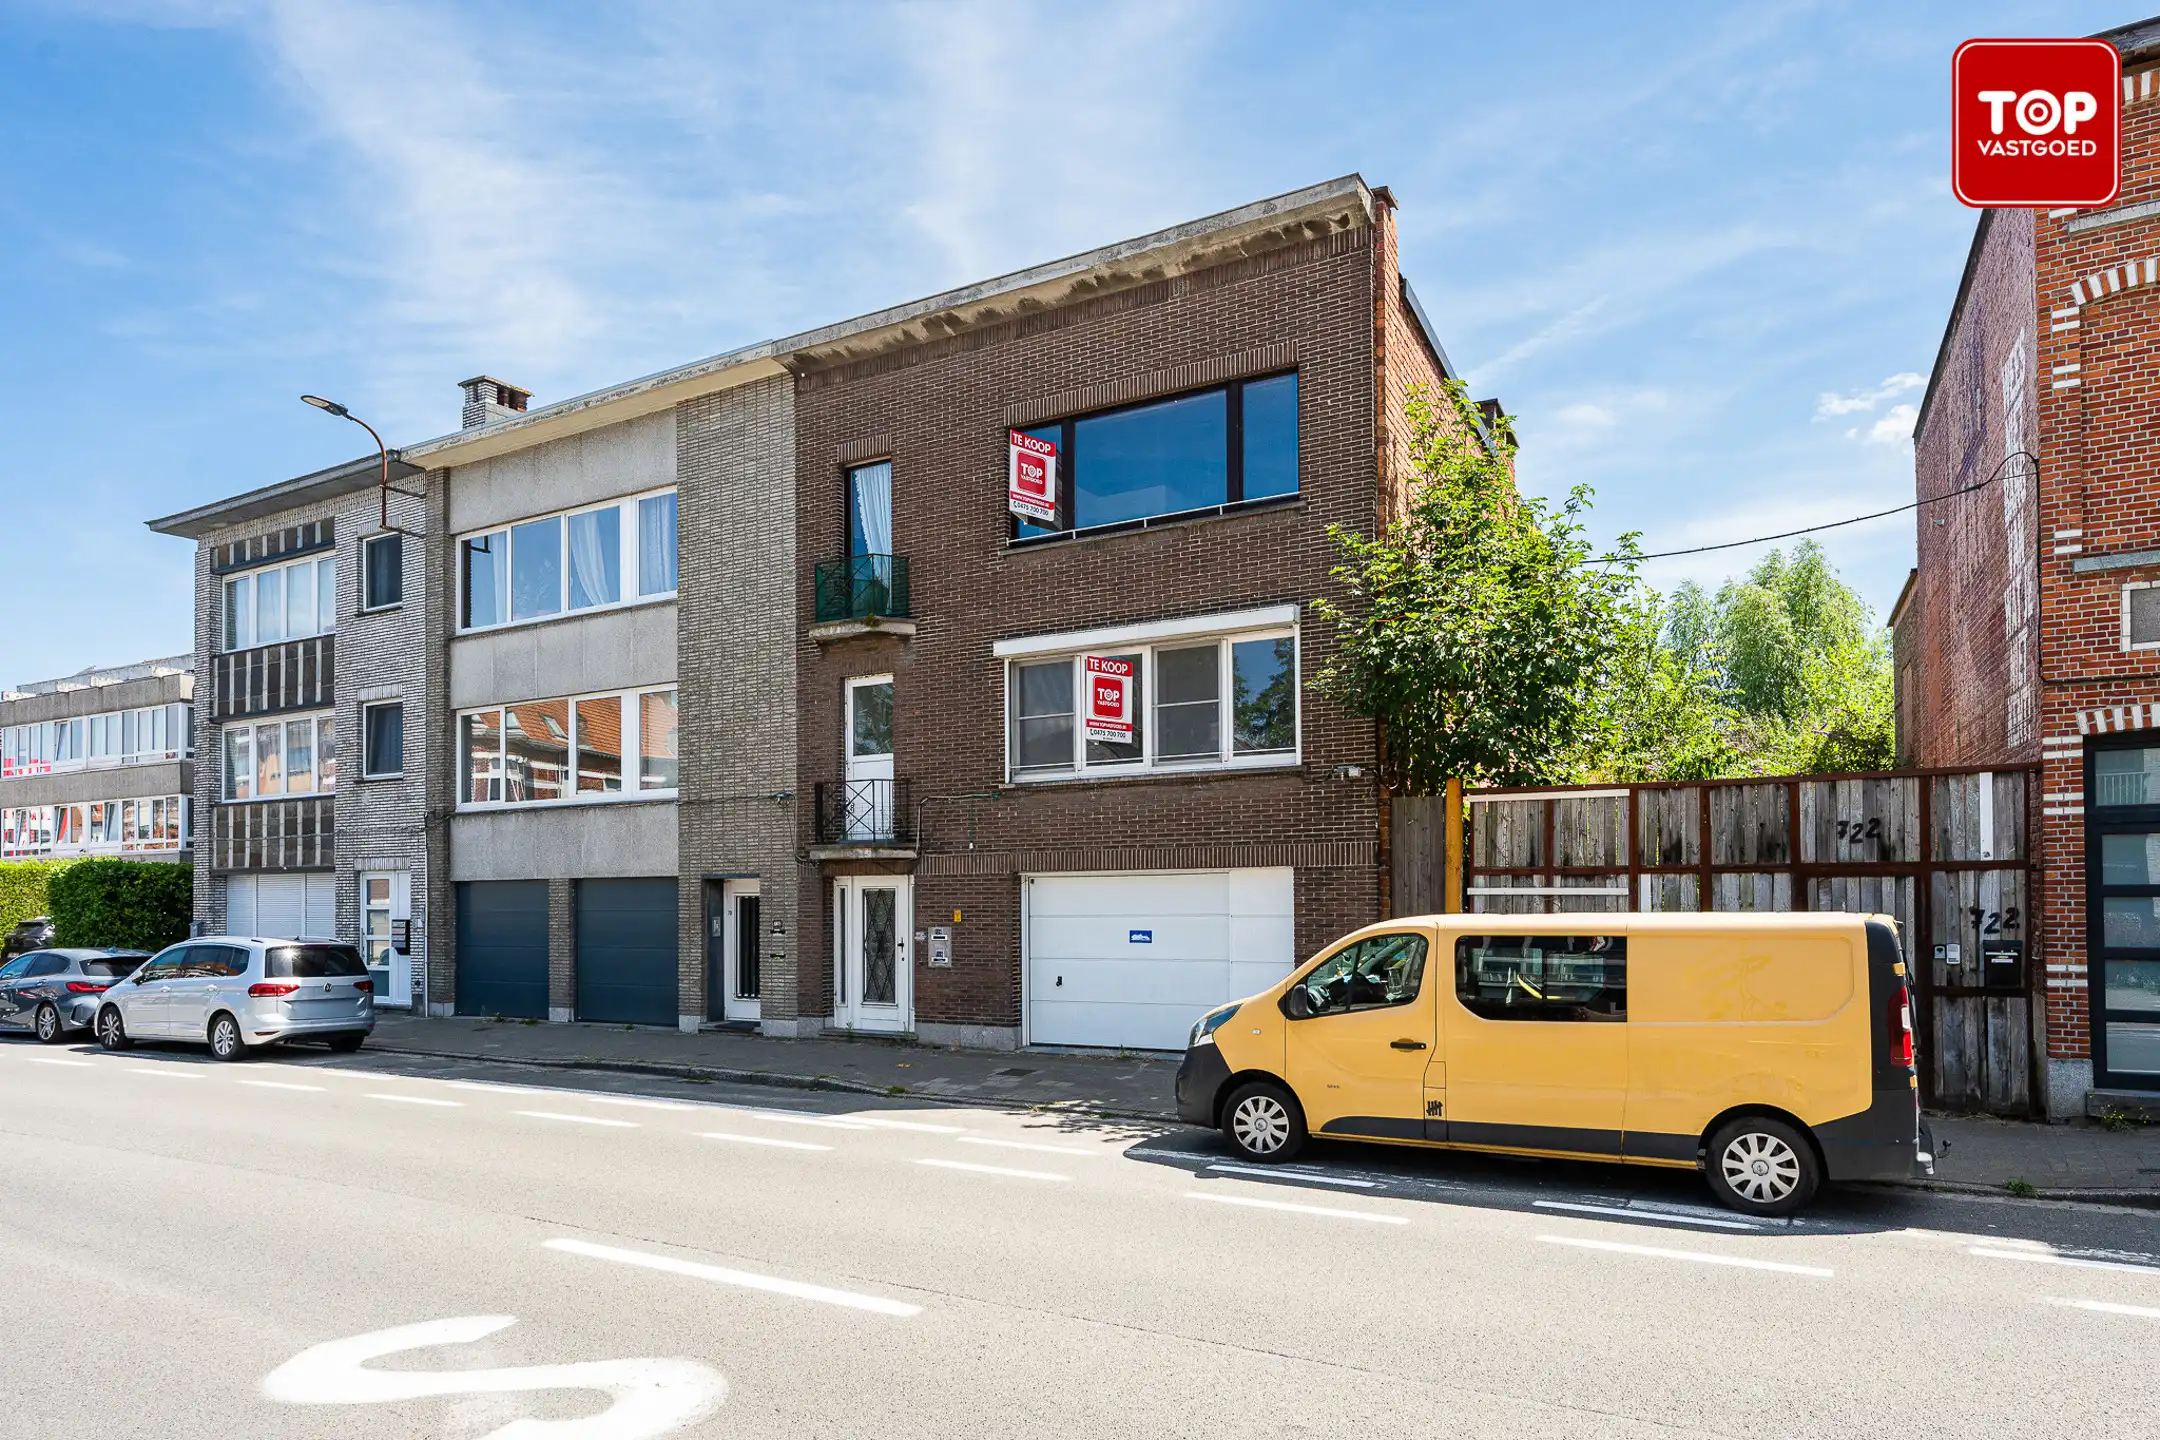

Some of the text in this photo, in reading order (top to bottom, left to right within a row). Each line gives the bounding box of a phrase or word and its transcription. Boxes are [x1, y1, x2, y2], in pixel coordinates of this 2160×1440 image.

[1012, 433, 1051, 454] TE KOOP
[1021, 463, 1043, 479] TOP
[1089, 658, 1128, 674] TE KOOP
[1097, 688, 1120, 701] TOP
[1093, 729, 1106, 737] 0475
[1107, 730, 1116, 738] 700
[1116, 731, 1126, 739] 700
[1837, 817, 1881, 844] 722
[1969, 907, 2021, 935] 722
